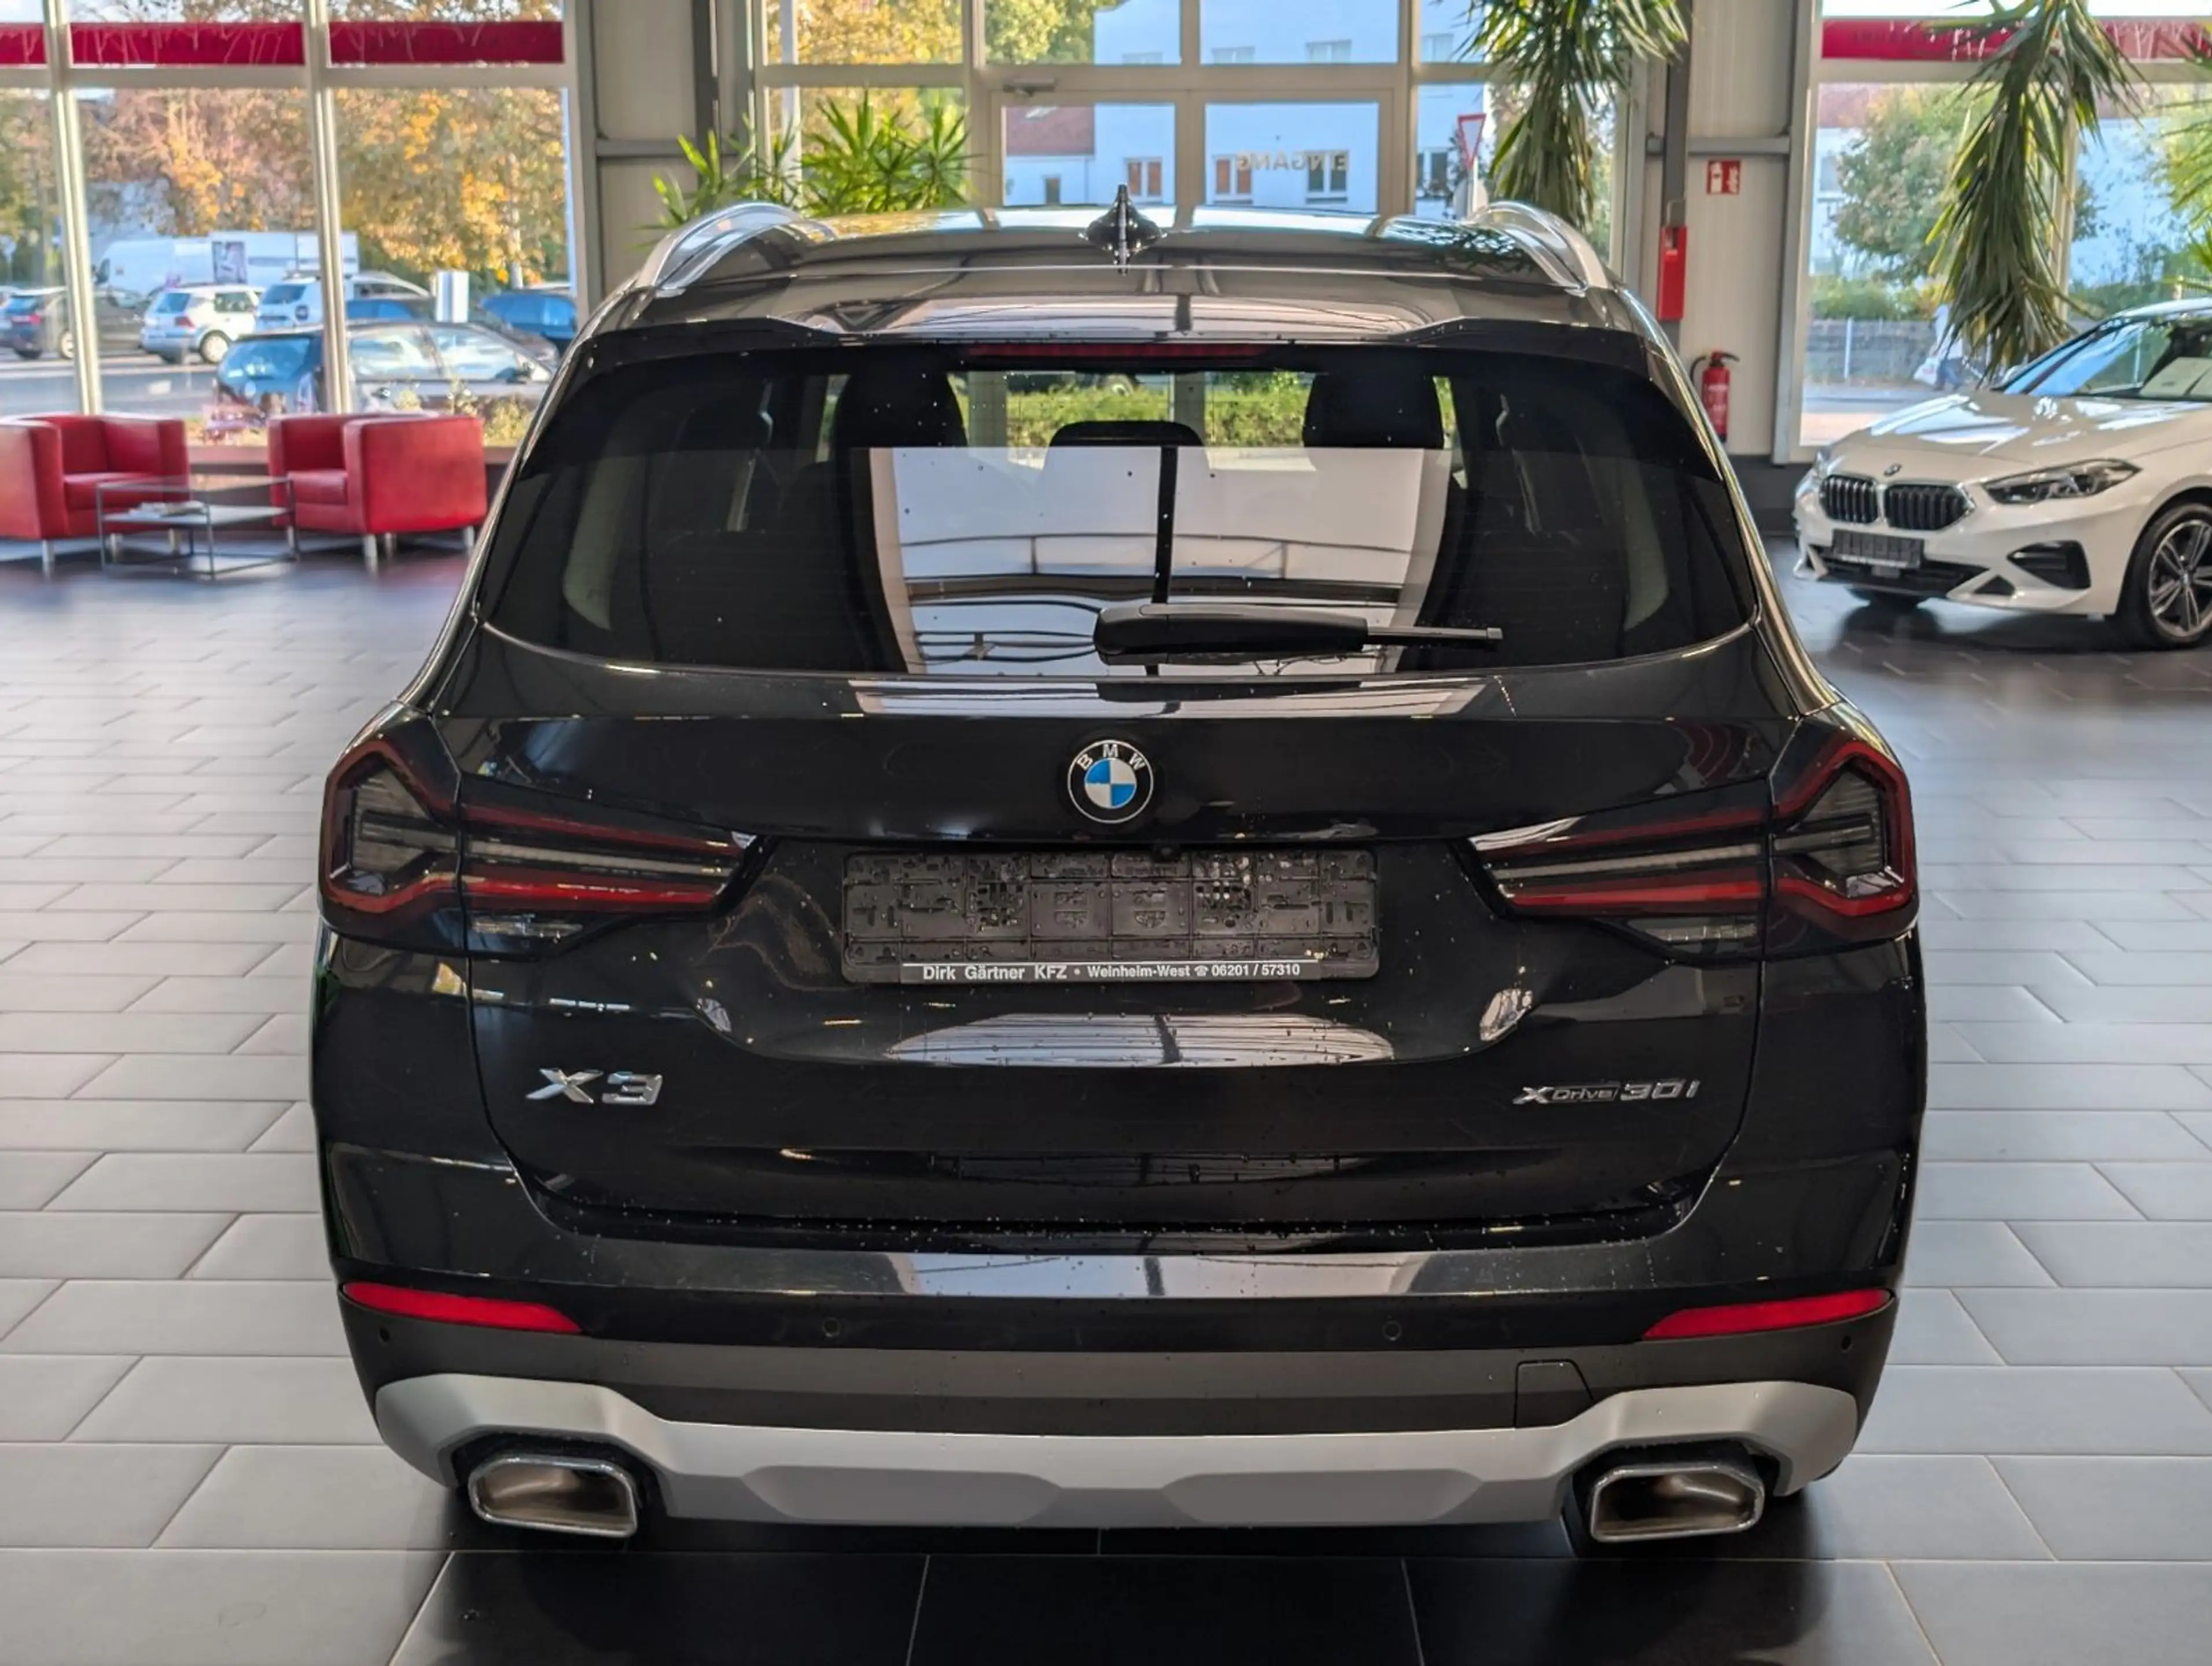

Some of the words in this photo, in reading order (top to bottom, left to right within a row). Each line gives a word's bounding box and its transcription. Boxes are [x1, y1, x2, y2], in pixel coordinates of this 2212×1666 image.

[1077, 744, 1146, 770] BMW
[923, 965, 956, 979] Dirk
[965, 965, 1025, 979] Gärtner
[1034, 965, 1068, 979] KFZ
[1087, 965, 1191, 978] Weinheim-West
[1211, 964, 1249, 976] 06201
[1261, 964, 1300, 976] 57310
[525, 1068, 662, 1105] X3
